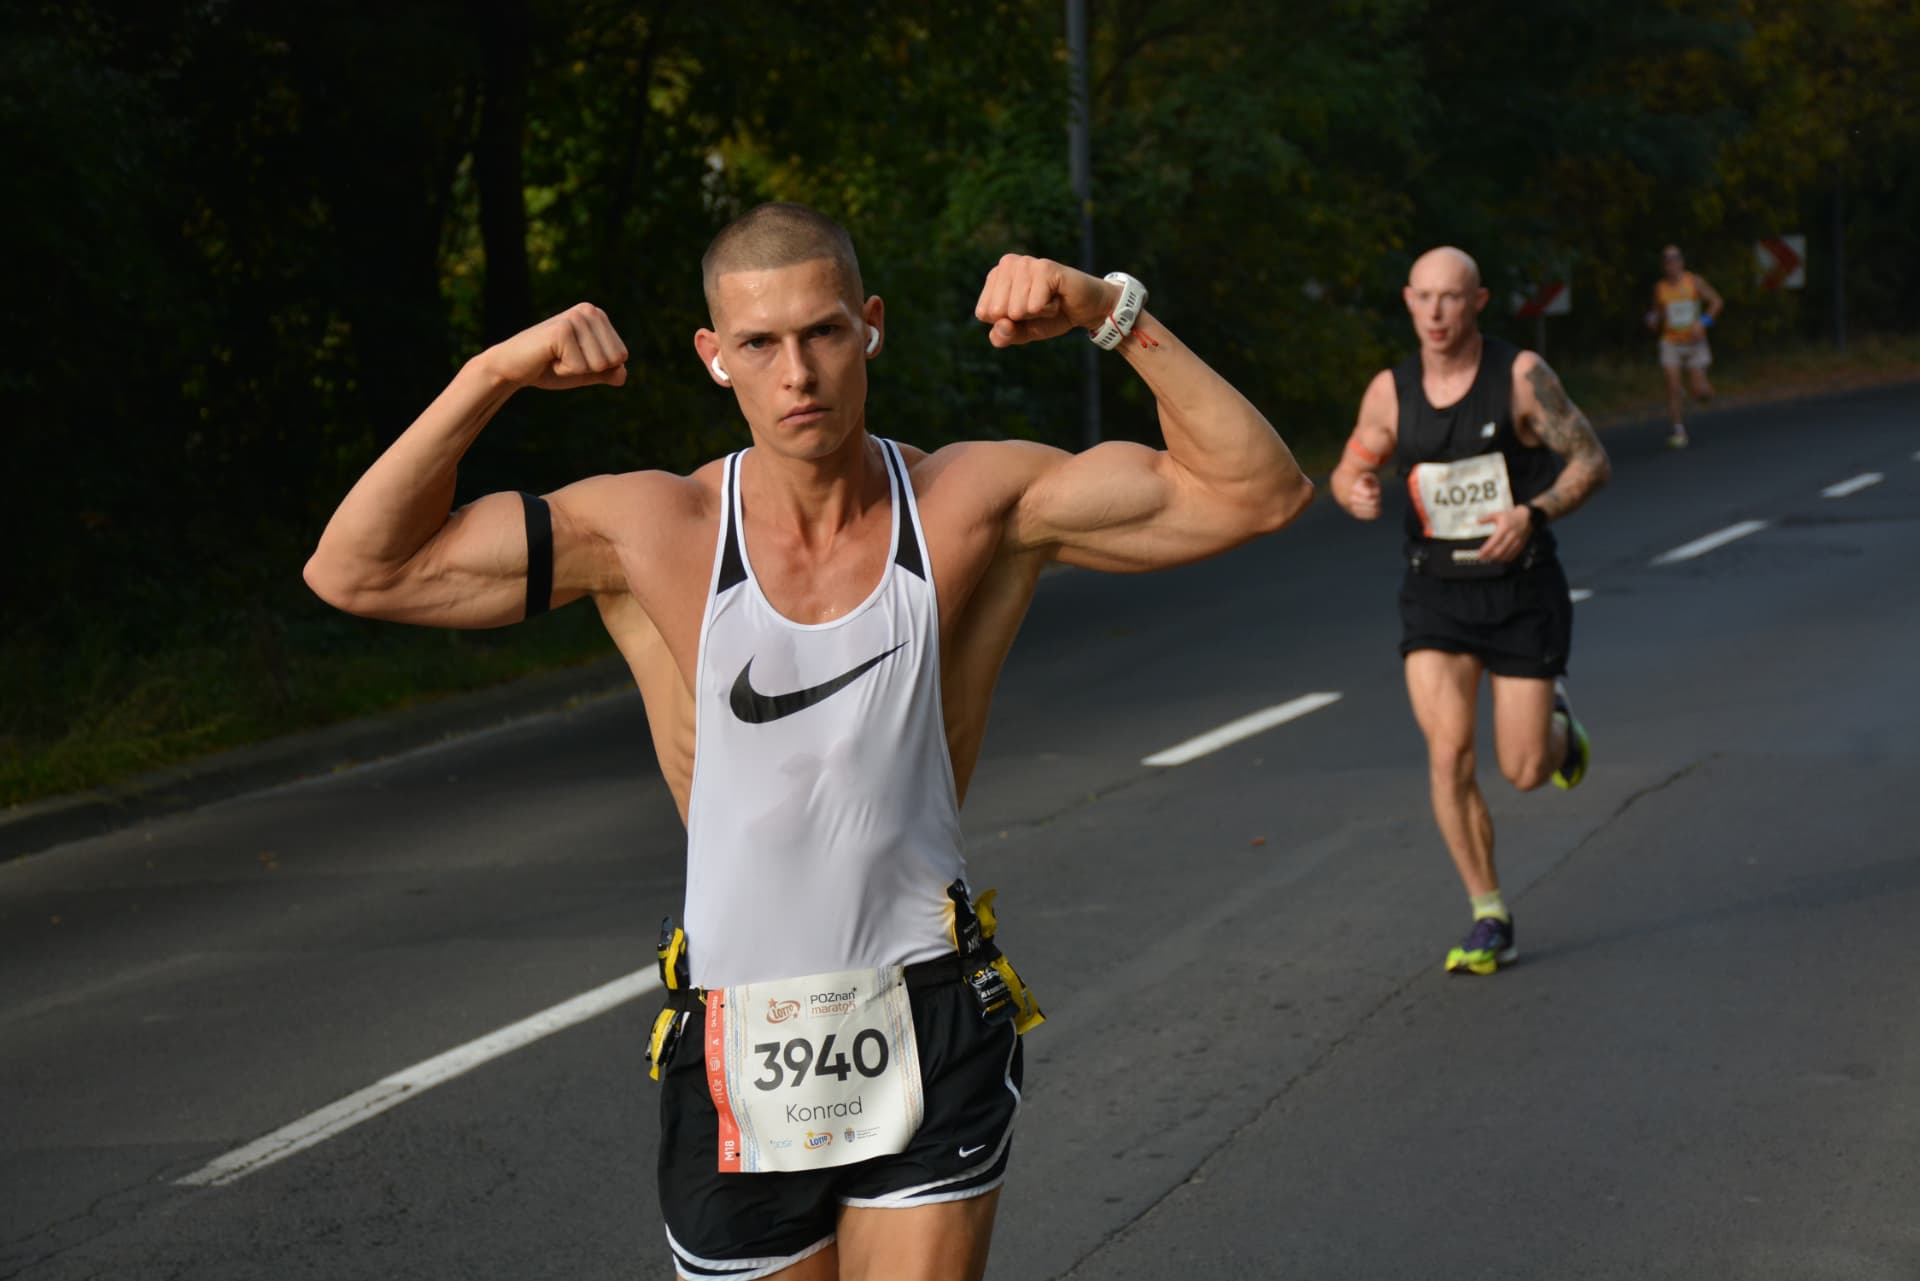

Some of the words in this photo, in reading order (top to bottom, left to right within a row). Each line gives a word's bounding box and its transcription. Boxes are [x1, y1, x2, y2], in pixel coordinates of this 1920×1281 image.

[1434, 480, 1498, 507] 4028
[754, 1028, 889, 1091] 3940
[786, 1096, 863, 1123] Konrad
[724, 1139, 735, 1161] M18
[809, 1135, 829, 1147] LOTTO
